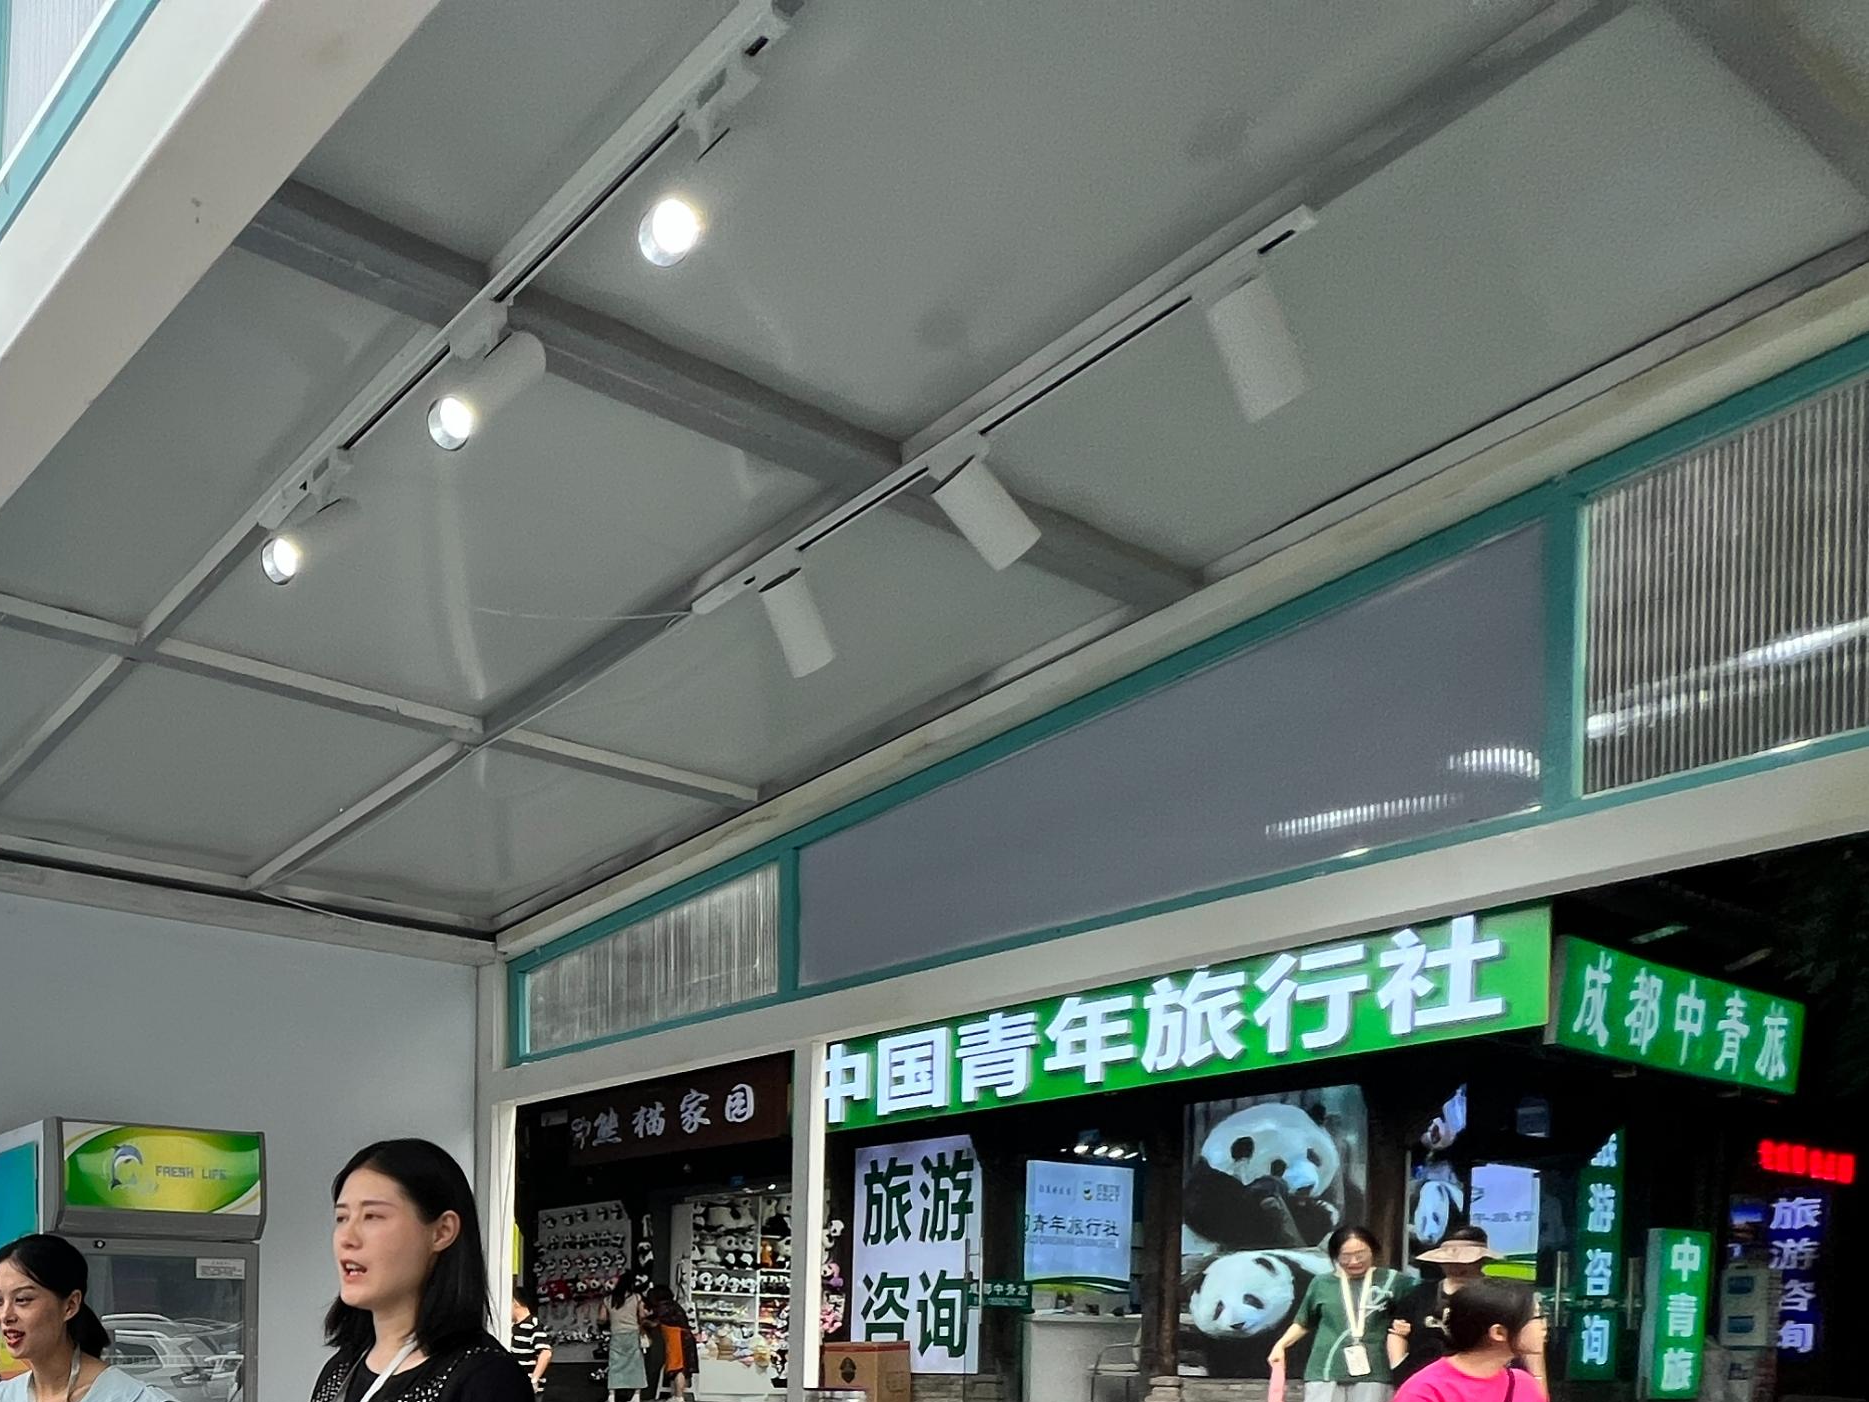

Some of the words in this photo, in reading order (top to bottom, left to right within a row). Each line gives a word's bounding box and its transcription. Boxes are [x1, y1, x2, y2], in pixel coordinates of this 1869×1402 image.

[824, 914, 1506, 1124] 中国青年旅行社
[1571, 950, 1791, 1081] 成都中青旅
[155, 1165, 194, 1179] FRESH
[201, 1168, 228, 1180] LIFE
[863, 1148, 975, 1247] 旅游
[861, 1270, 969, 1360] 咨询
[1660, 1236, 1702, 1392] 中青旅
[1768, 1196, 1822, 1354] 旅游咨询
